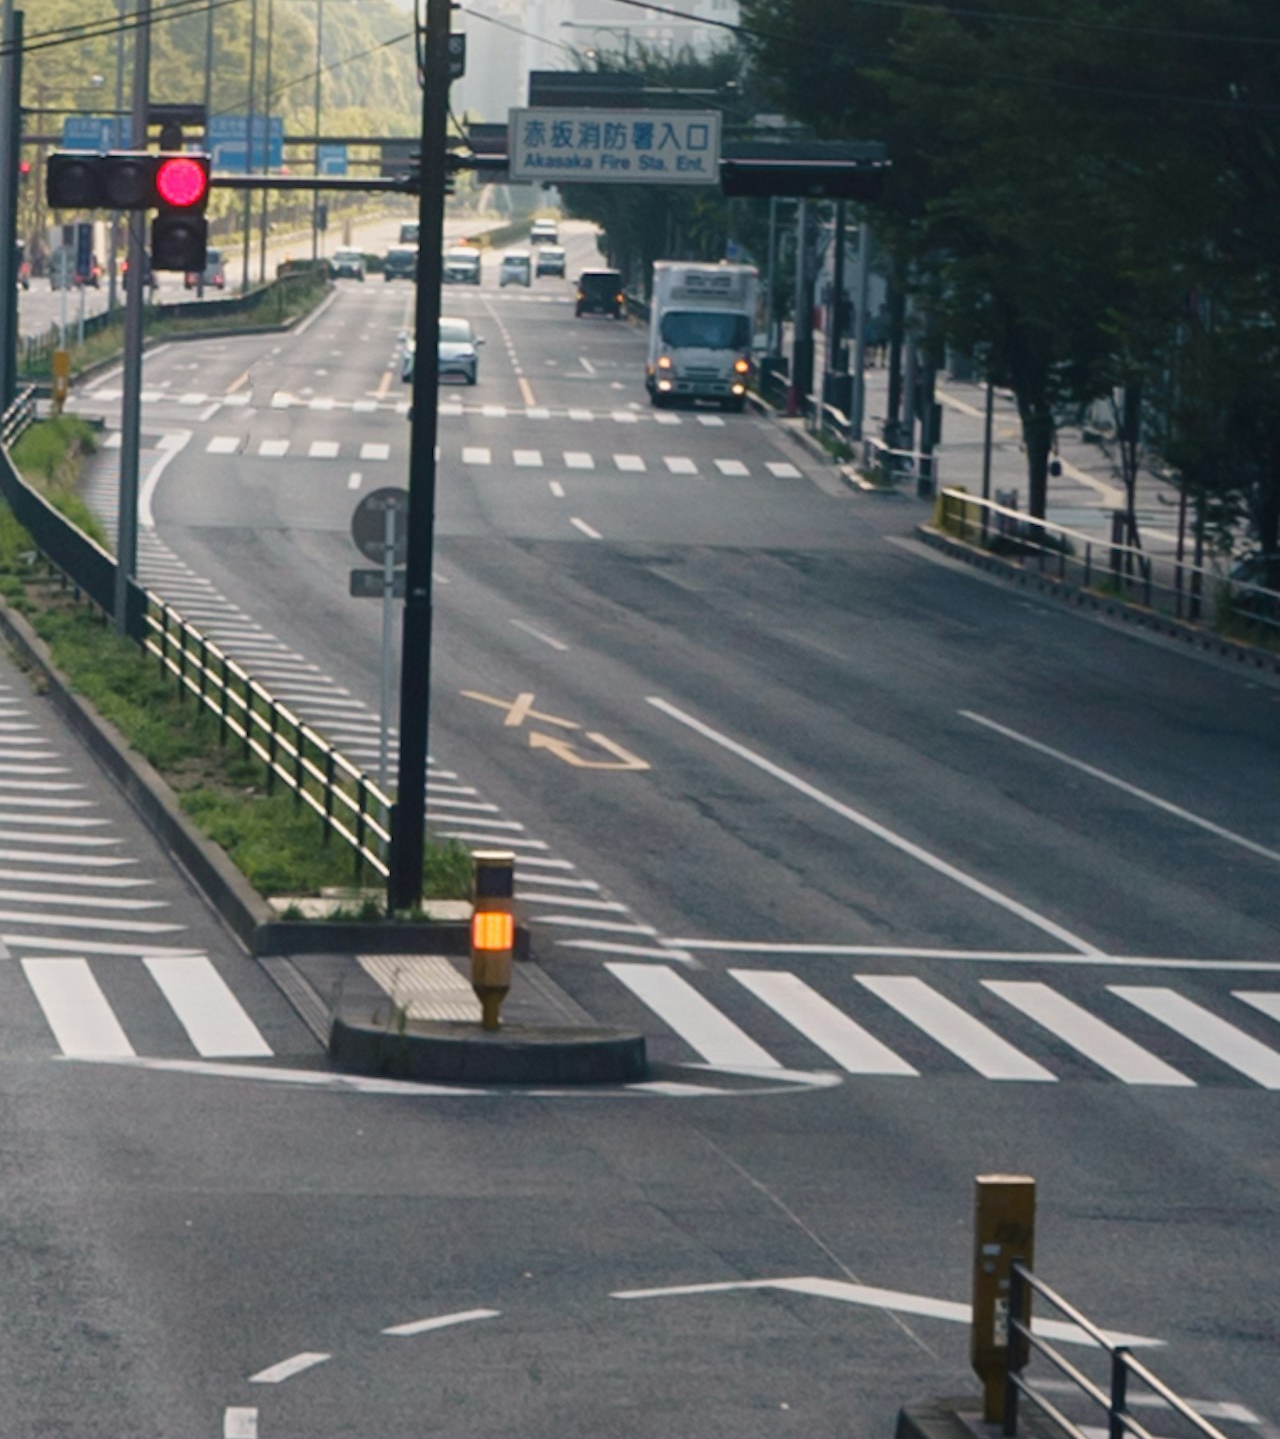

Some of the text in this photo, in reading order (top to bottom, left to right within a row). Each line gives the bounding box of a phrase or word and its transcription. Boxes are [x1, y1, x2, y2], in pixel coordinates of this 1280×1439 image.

[524, 120, 709, 151] 赤坂消防署入口
[524, 153, 707, 172] Akasaka Fire Sta. Ent.
